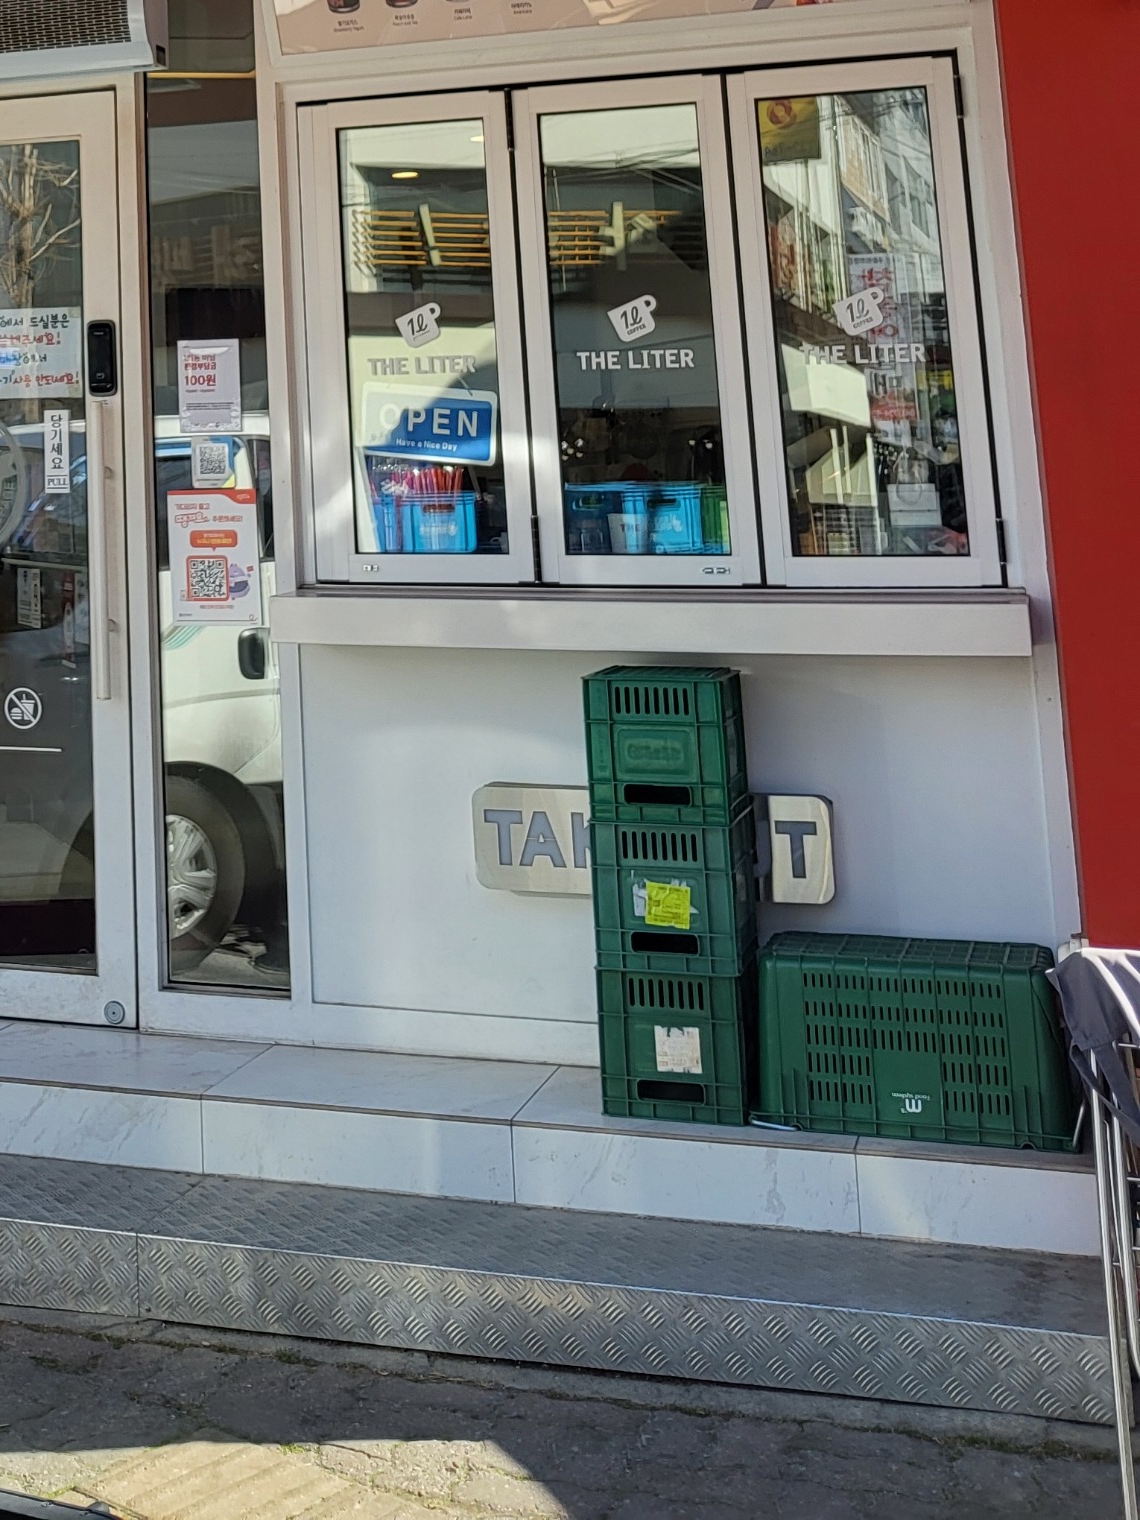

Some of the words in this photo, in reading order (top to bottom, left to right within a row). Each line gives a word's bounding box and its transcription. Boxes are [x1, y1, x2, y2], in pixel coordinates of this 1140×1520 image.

[29, 313, 70, 329] 드실분은
[852, 317, 873, 329] COFFEE
[627, 323, 647, 336] COFFEE
[0, 352, 47, 367] 매장에서
[576, 351, 621, 370] THE
[627, 349, 695, 369] LITER
[799, 345, 847, 365] THE
[854, 343, 926, 364] LITER
[367, 357, 410, 376] THE
[414, 355, 477, 374] LITER
[185, 374, 217, 387] 100원
[379, 403, 478, 437] OPEN
[50, 414, 64, 470] 당기세요
[396, 437, 416, 447] Have
[424, 440, 441, 449] Nice
[442, 442, 458, 453] Day
[47, 477, 69, 486] PULL
[484, 809, 592, 869] TAK
